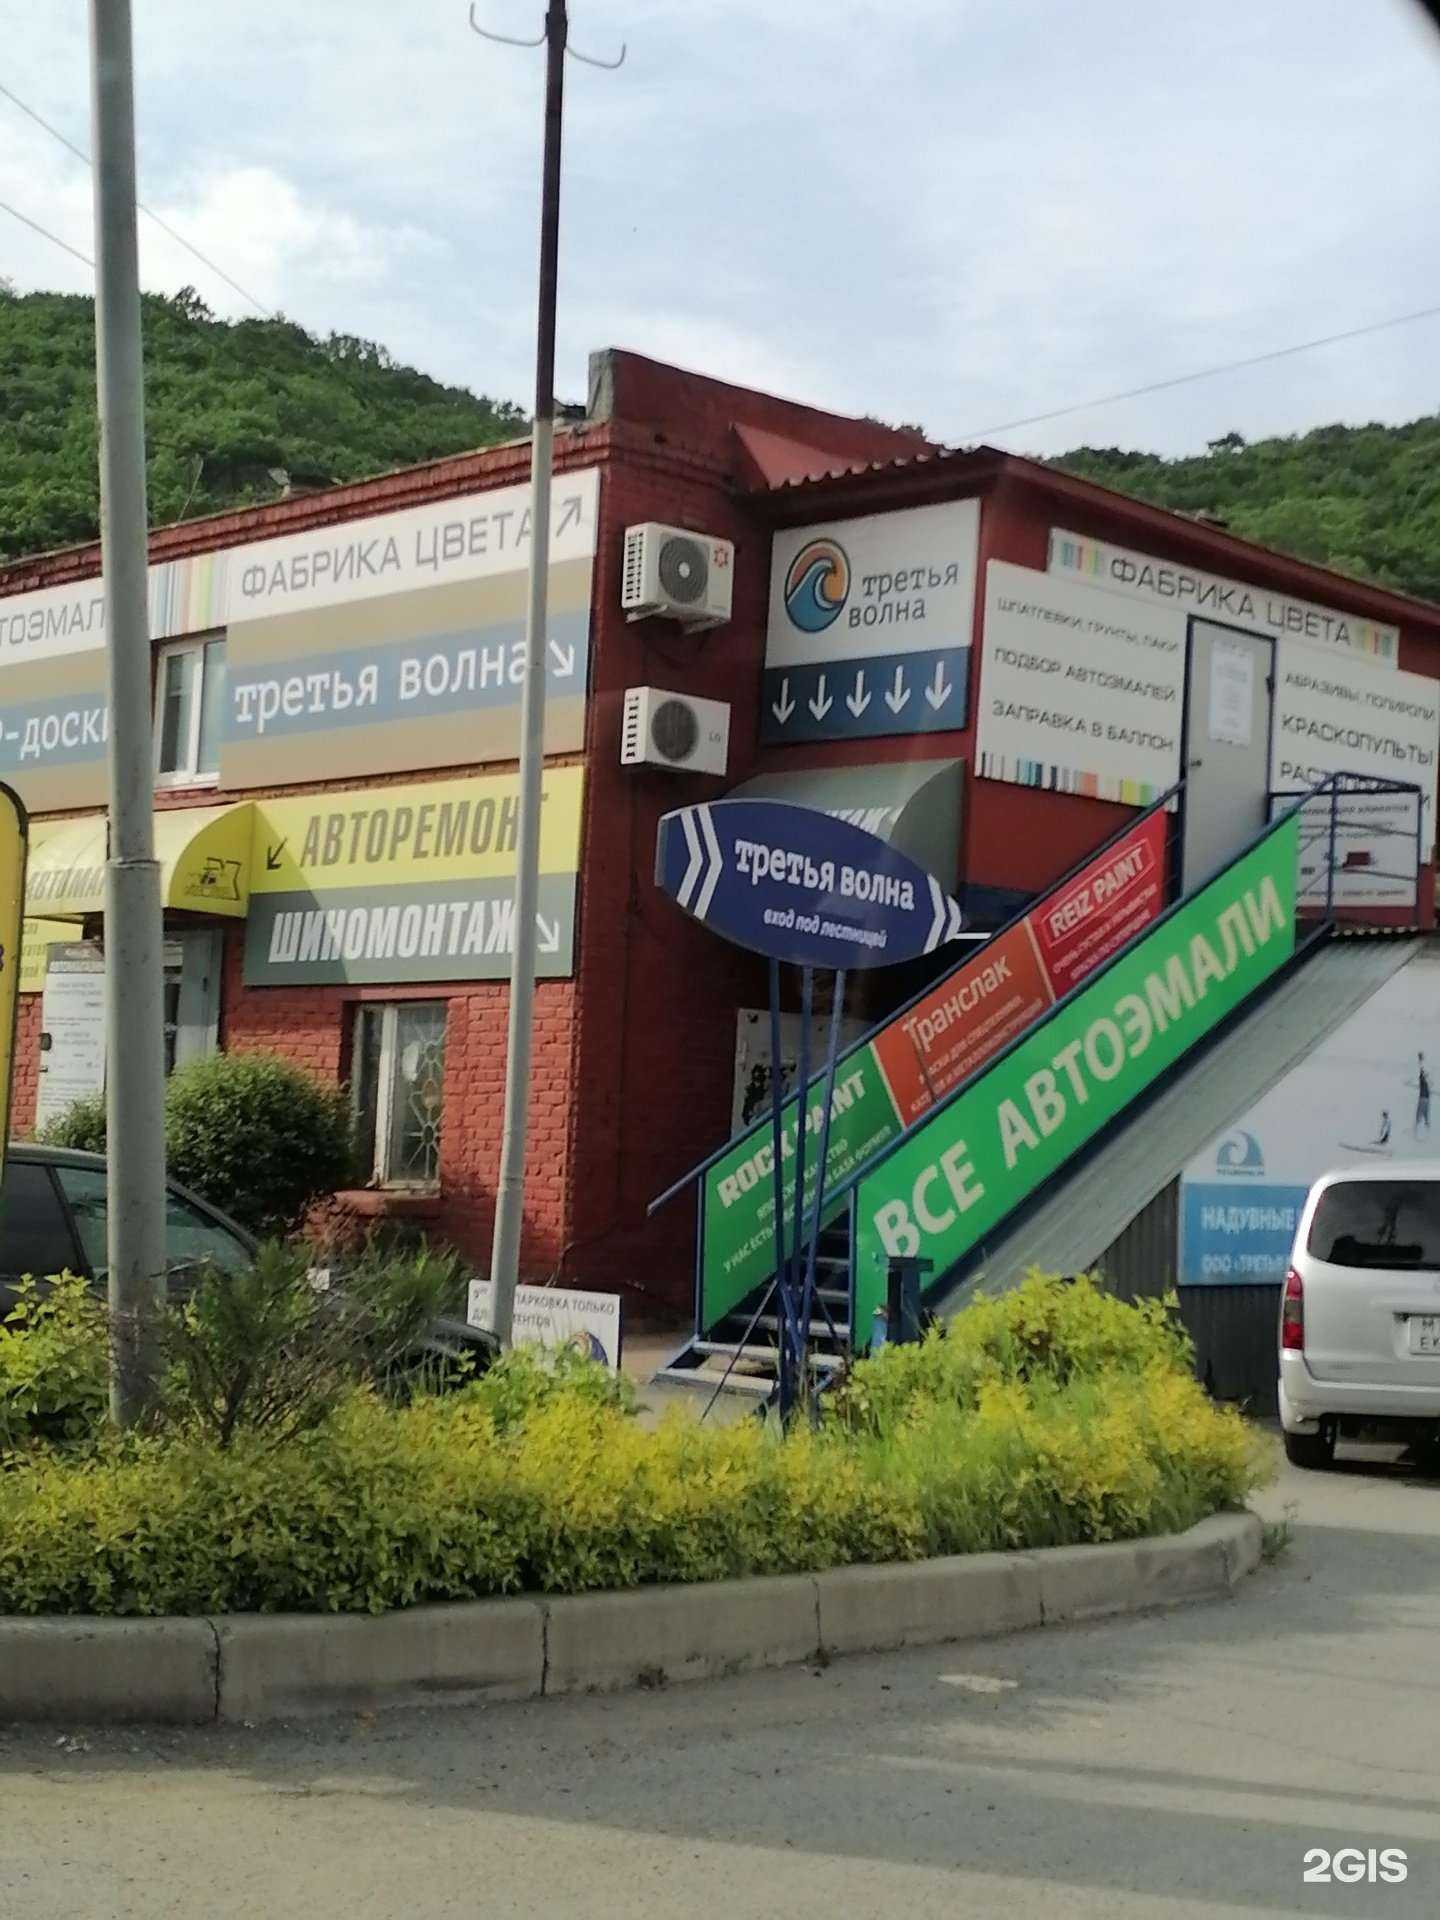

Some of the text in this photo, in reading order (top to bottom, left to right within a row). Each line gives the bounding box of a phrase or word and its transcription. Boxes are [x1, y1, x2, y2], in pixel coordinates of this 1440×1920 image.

[241, 506, 533, 600] ФАБРИКА ЦВЕТА
[861, 561, 960, 602] третья
[1110, 556, 1352, 648] ФАБРИКА ЦВЕТА
[0, 597, 105, 648] ТОЭМАЛ
[848, 598, 927, 630] волна
[234, 640, 527, 734] третья волна
[994, 647, 1177, 703] ПОДБОР АВТОЭМАЛЕЙ
[992, 698, 1174, 751] ЗАПРАВКА В БАЛЛОН
[1280, 713, 1434, 767] КРАСКОПУЛЬТЫ
[735, 838, 915, 912] третья волна
[1049, 889, 1095, 939] REIZ
[1091, 846, 1146, 904] PAINT
[267, 898, 514, 964] ШИНОМОНТАЖ
[762, 907, 795, 929] вход
[794, 914, 820, 938] под
[902, 954, 1013, 1054] Транслак
[873, 1138, 986, 1259] ВСЕ
[996, 874, 1288, 1170] АВТОЭМАЛИ
[1201, 1205, 1295, 1236] НАДУВНЫЕ
[572, 1299, 616, 1317] ТОЛЬКО
